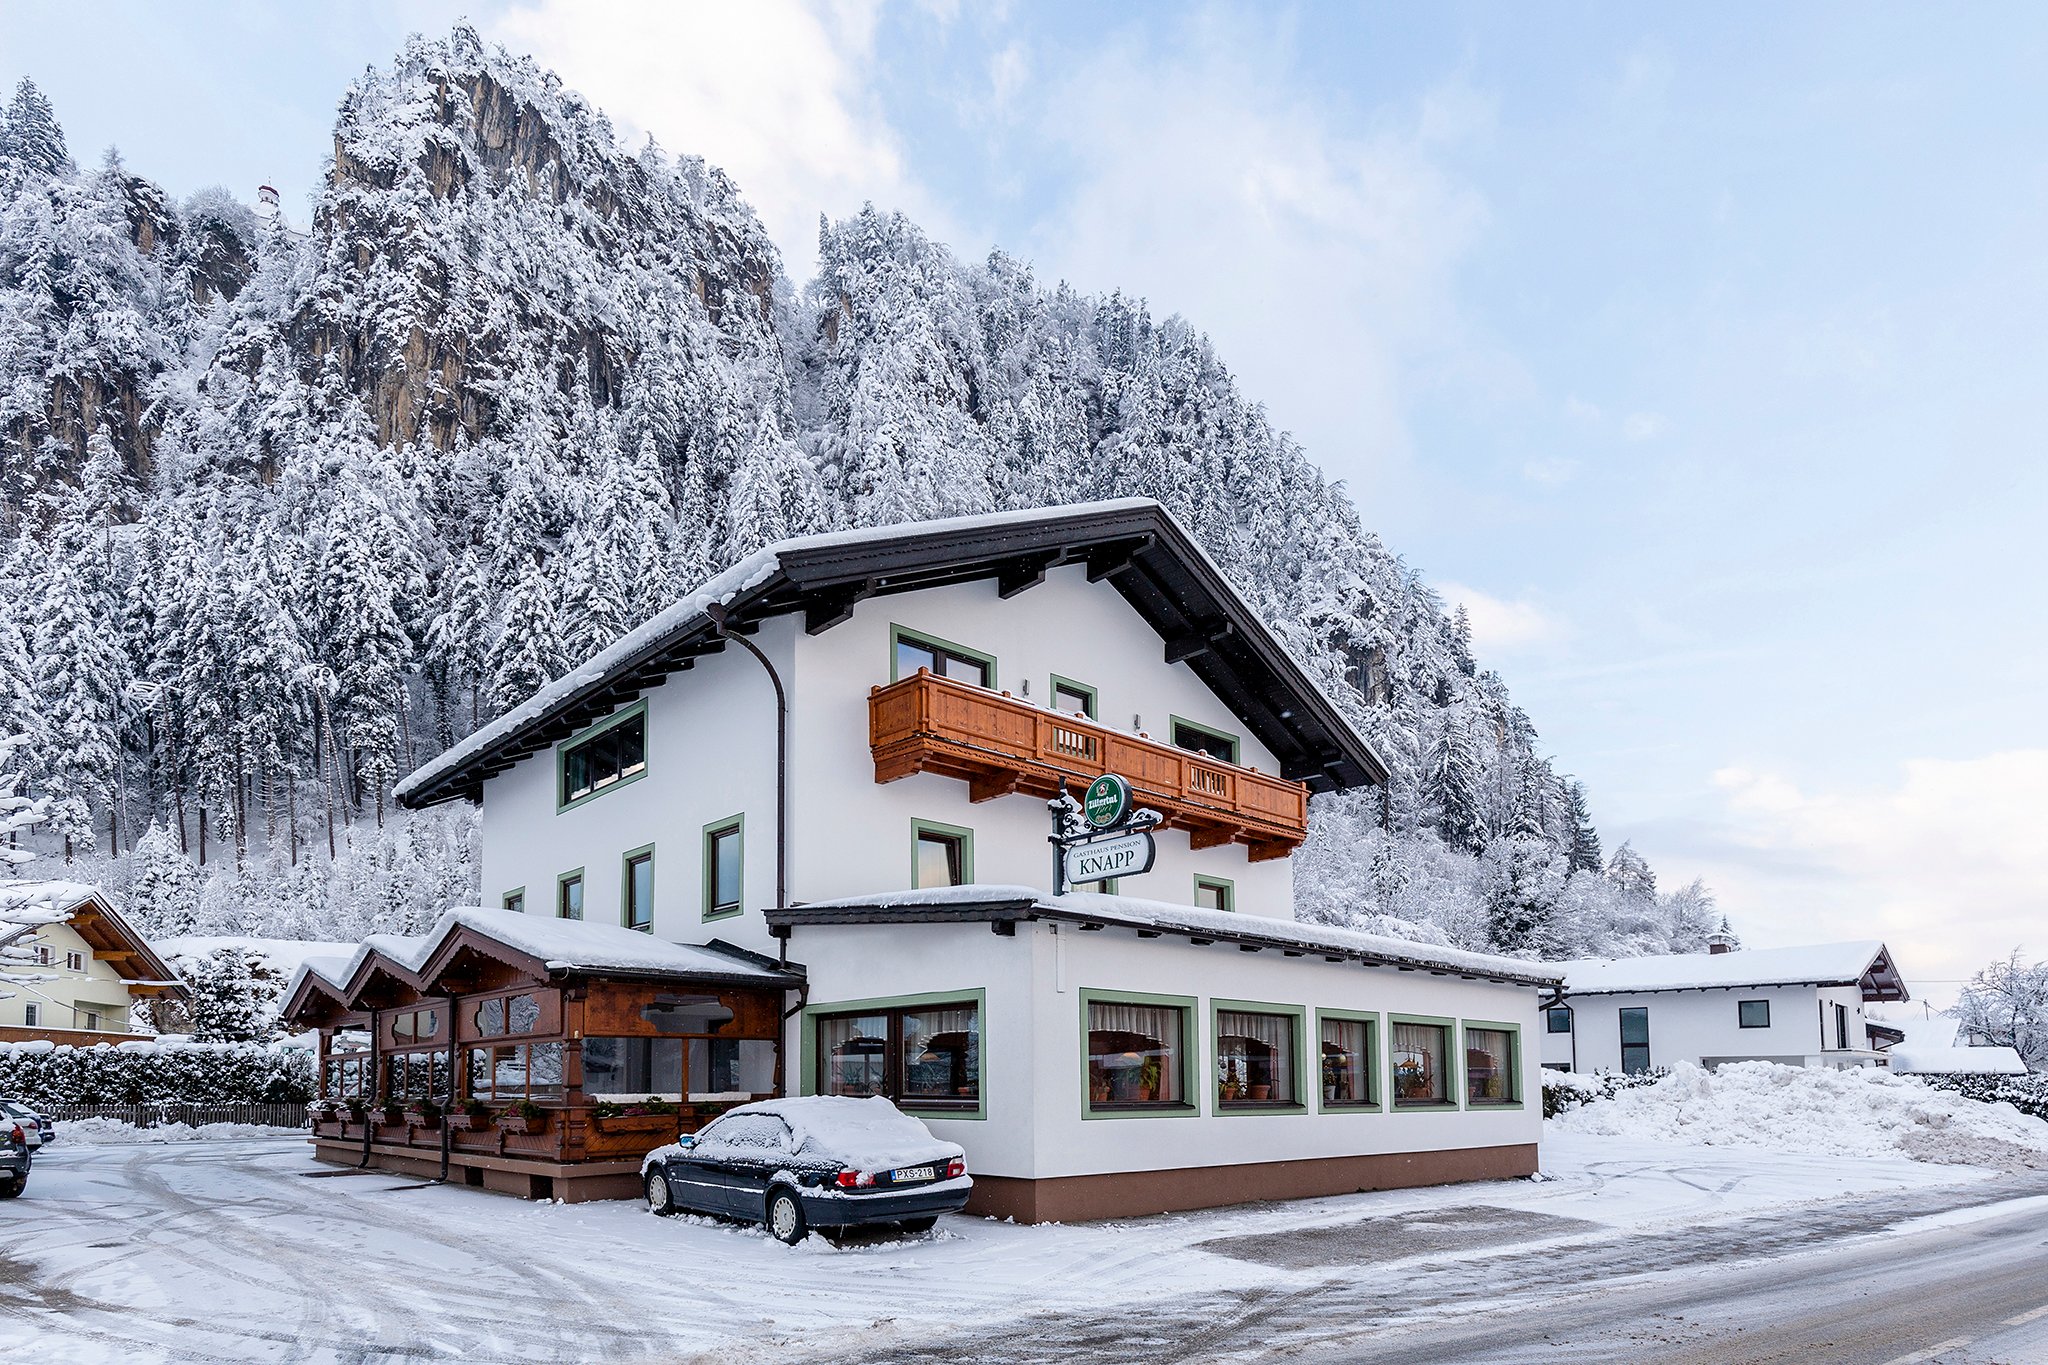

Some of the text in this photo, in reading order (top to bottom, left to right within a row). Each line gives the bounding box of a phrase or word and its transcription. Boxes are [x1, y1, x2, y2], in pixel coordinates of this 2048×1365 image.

[1088, 794, 1118, 810] Zillertal
[1073, 840, 1141, 859] GASTHAUS PENSION
[1080, 850, 1135, 876] KNAPP
[896, 1168, 933, 1179] PXS-218
